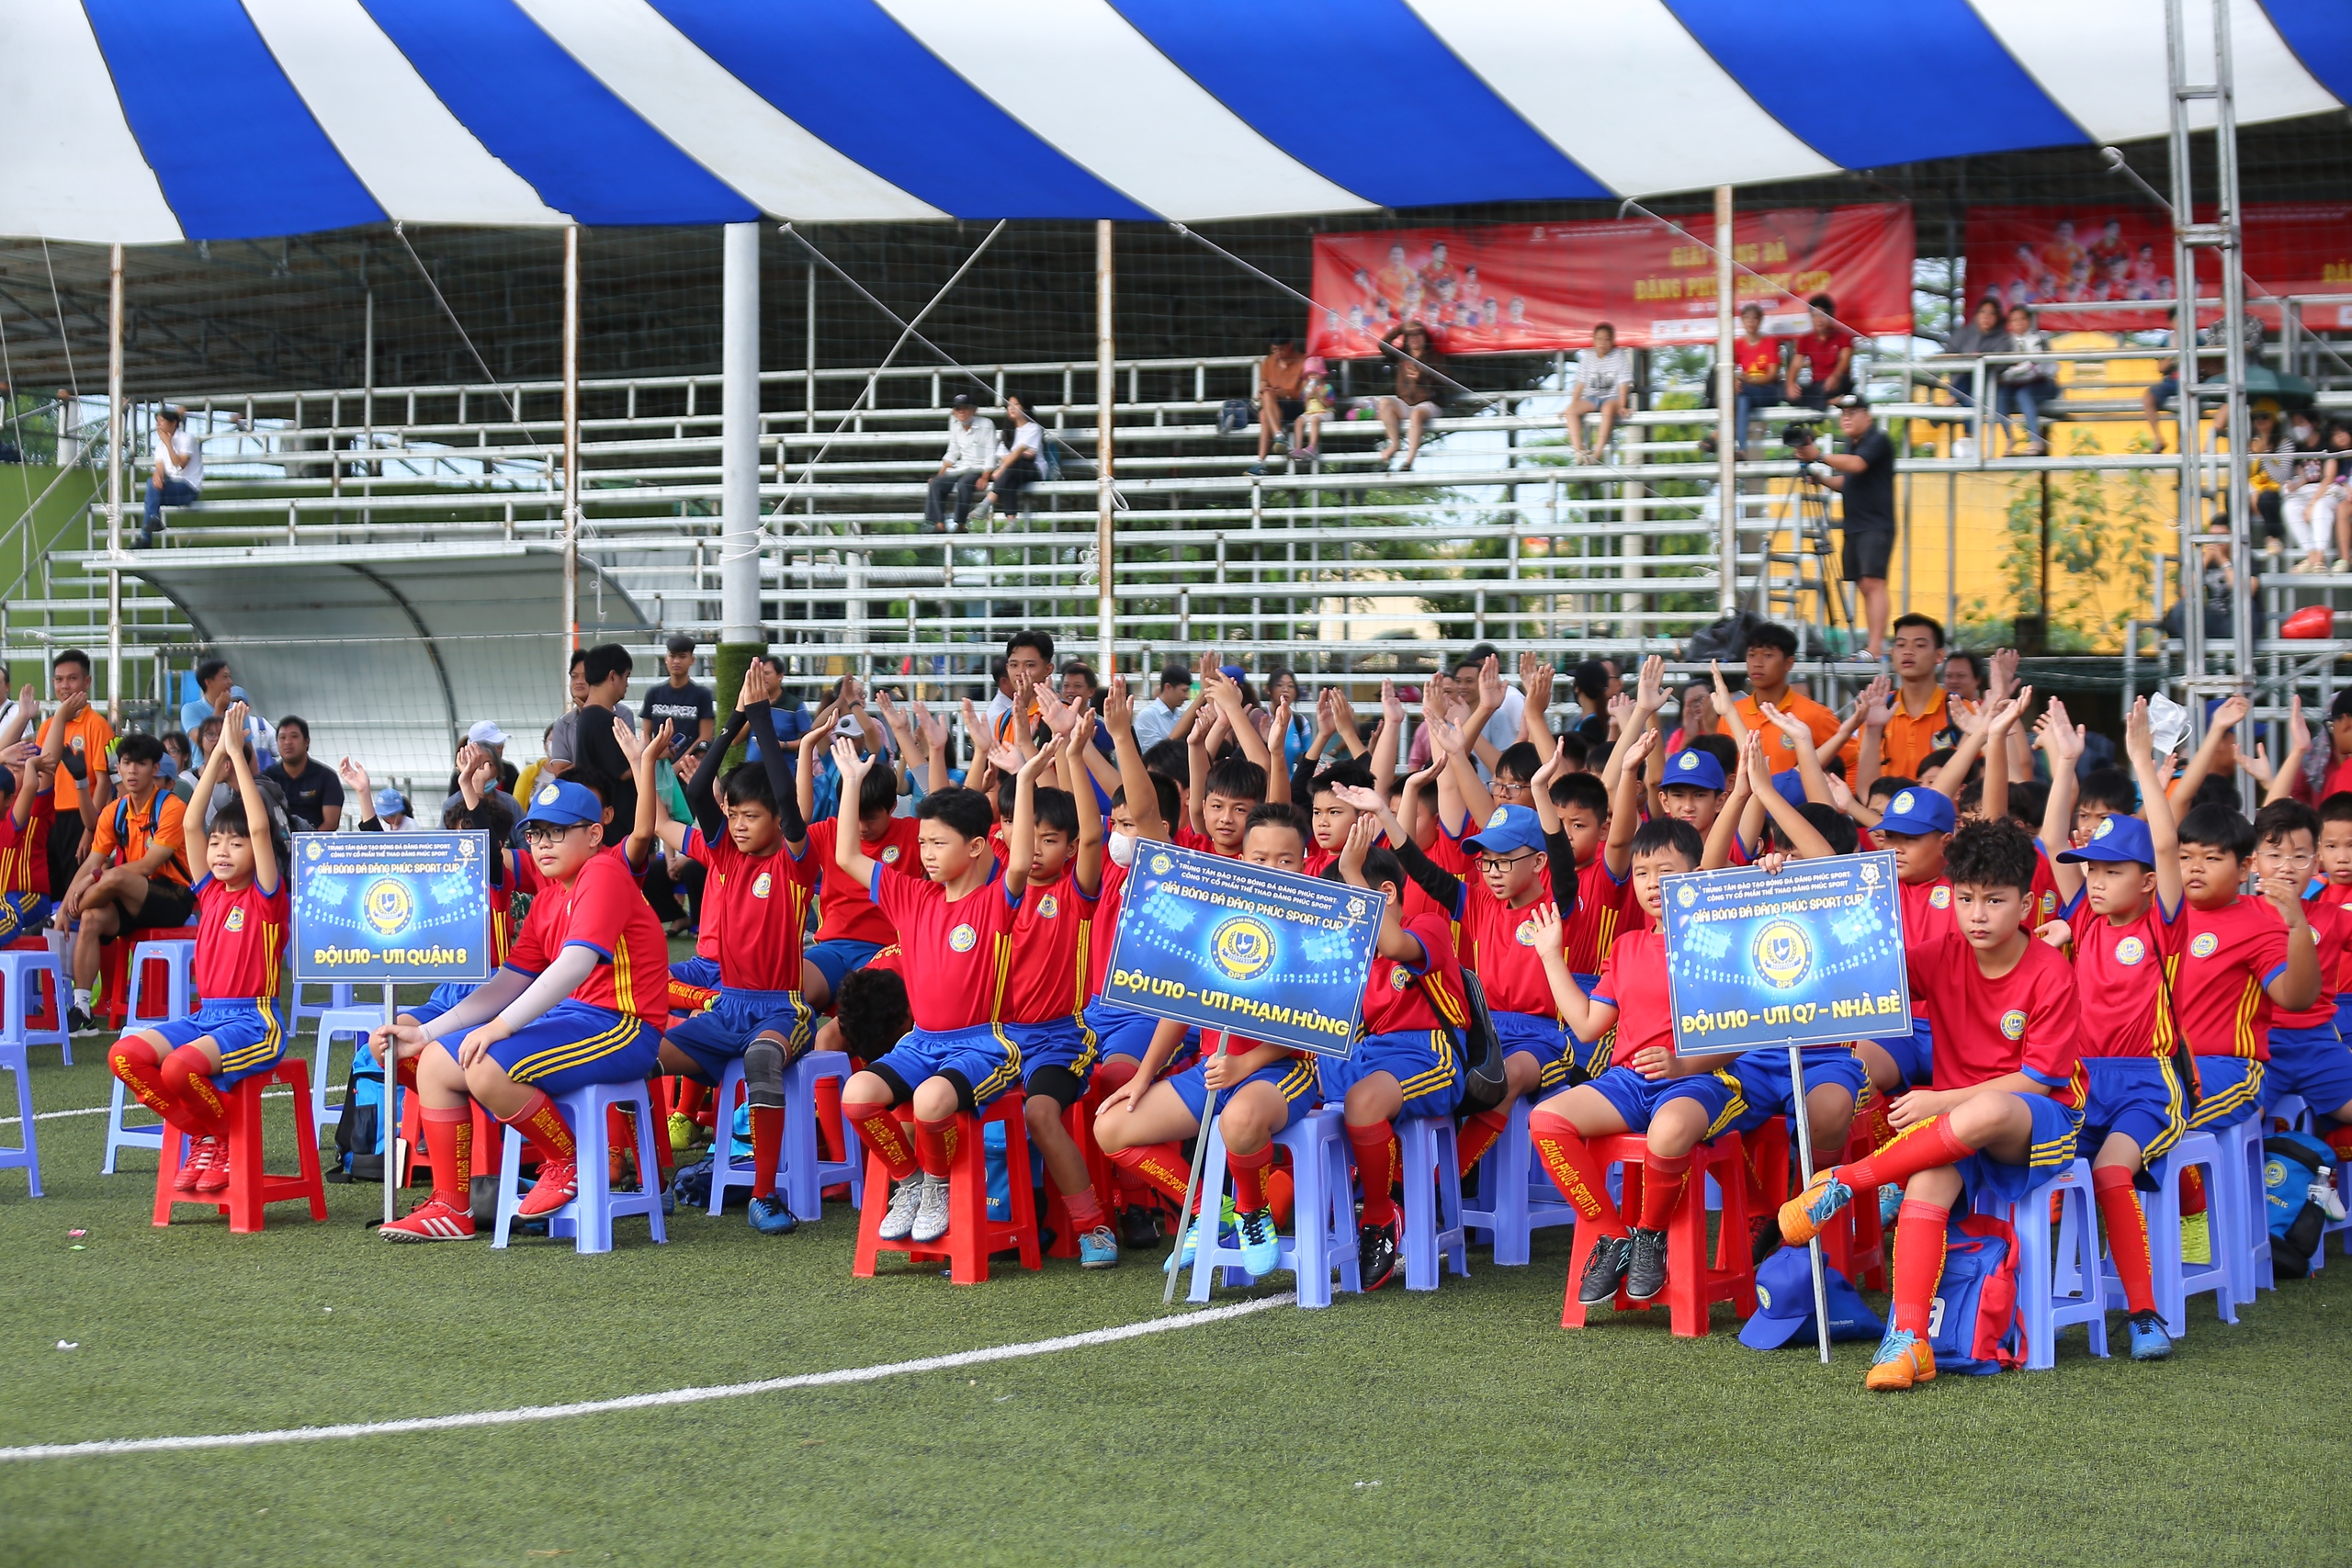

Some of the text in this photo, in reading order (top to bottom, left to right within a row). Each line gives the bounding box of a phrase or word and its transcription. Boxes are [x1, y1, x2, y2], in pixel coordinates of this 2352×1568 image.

[356, 862, 367, 874] ĐÁ
[390, 861, 413, 873] PHÚC
[413, 863, 441, 873] SPORT
[443, 863, 459, 872] CUP
[1178, 863, 1337, 903] TRUNG TÂM ĐÀO TẠO BÓNG ĐÁ ĐĂNG PHÚC SPORT
[1181, 871, 1200, 881] CÔNG
[1209, 877, 1220, 886] CỔ
[1253, 887, 1272, 897] THAO
[1272, 892, 1292, 901] ĐĂNG
[1292, 897, 1310, 906] PHÚC
[1310, 900, 1332, 910] SPORT
[1702, 886, 1723, 894] TRUNG
[1723, 883, 1736, 891] TÂM
[1751, 880, 1765, 888] TẠO
[1765, 878, 1782, 886] BÓNG
[1793, 874, 1812, 883] ĐĂNG
[1813, 873, 1829, 881] PHÚC
[1830, 871, 1850, 879] SPORT
[1706, 894, 1724, 902] CÔNG
[1792, 884, 1810, 892] ĐĂNG
[1810, 881, 1827, 890] PHÚC
[1827, 880, 1849, 888] SPORT
[1209, 891, 1226, 905] ĐÁ
[1255, 902, 1284, 919] PHÚC
[1284, 908, 1321, 927] SPORT
[1320, 917, 1344, 931] CUP
[1738, 903, 1753, 918] ĐÁ
[1781, 897, 1808, 913] PHÚC
[1808, 895, 1842, 910] SPORT
[1843, 893, 1864, 907] CUP
[314, 944, 342, 967] ĐỘI
[344, 948, 370, 964] U10
[382, 948, 405, 964] U11
[406, 943, 454, 967] QUẬN
[456, 948, 467, 963] 8
[1226, 969, 1247, 981] ĐPS
[1112, 967, 1150, 994] ĐỘI
[1149, 976, 1186, 1000] U10
[1199, 987, 1230, 1010] U11
[1229, 994, 1291, 1023] PHẠM
[1291, 1007, 1351, 1037] HÙNG
[1680, 1008, 1714, 1036] ĐỘI
[1715, 1009, 1749, 1030] U10
[1762, 1004, 1791, 1025] U11
[1792, 1002, 1817, 1024] Q7
[1830, 991, 1875, 1019] NHÀ
[1876, 988, 1901, 1014] BÈ
[159, 1100, 170, 1111] FC
[457, 1160, 469, 1183] SPORT
[1138, 1157, 1157, 1176] ĐĂNG
[1153, 1168, 1175, 1183] PHÚC
[1539, 1138, 1603, 1217] ĐĂNG PHÚC SPORT FC
[458, 1182, 469, 1193] FC
[992, 1198, 1000, 1207] FC
[2280, 1201, 2289, 1209] FC
